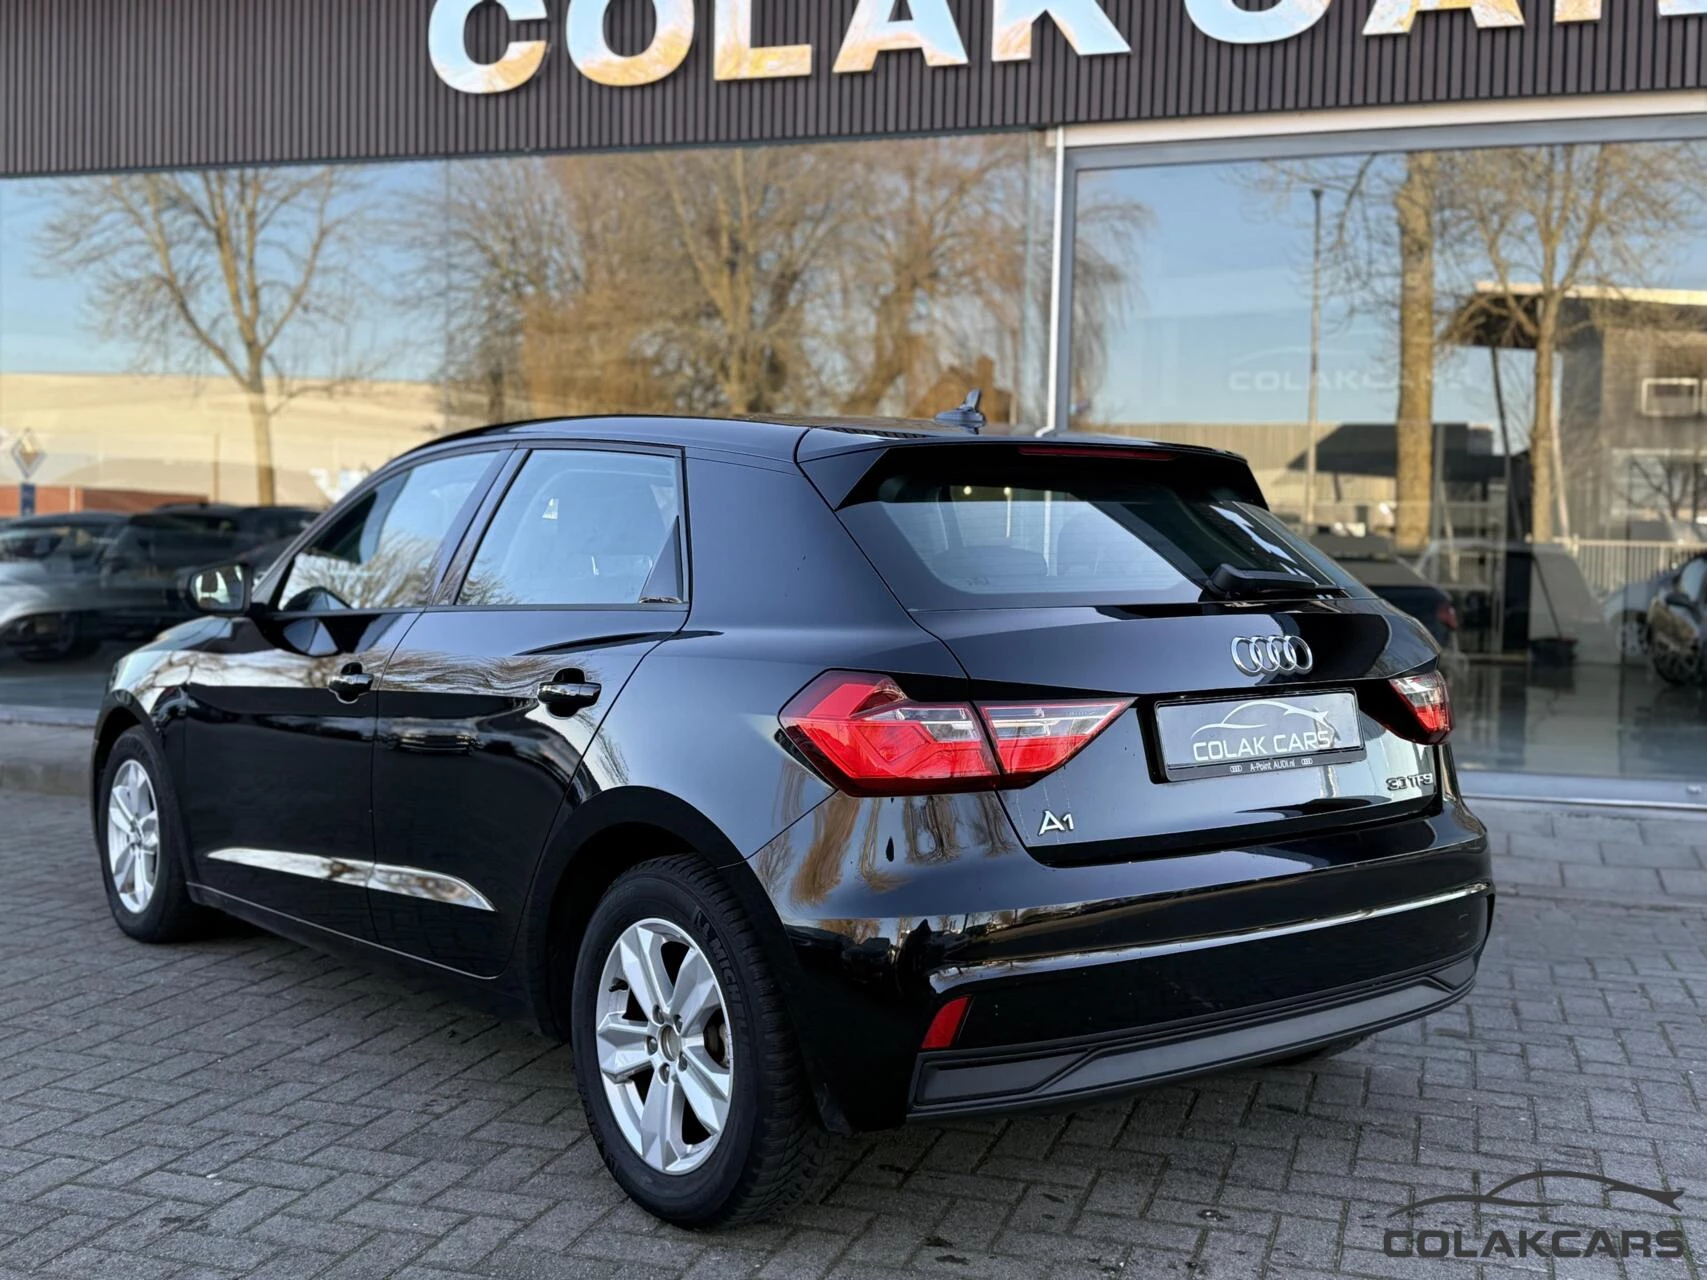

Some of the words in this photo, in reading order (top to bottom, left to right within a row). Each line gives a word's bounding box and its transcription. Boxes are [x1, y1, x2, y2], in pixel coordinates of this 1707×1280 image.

[1193, 736, 1266, 761] COLAK
[1273, 730, 1331, 752] CARS
[1038, 810, 1075, 836] A1
